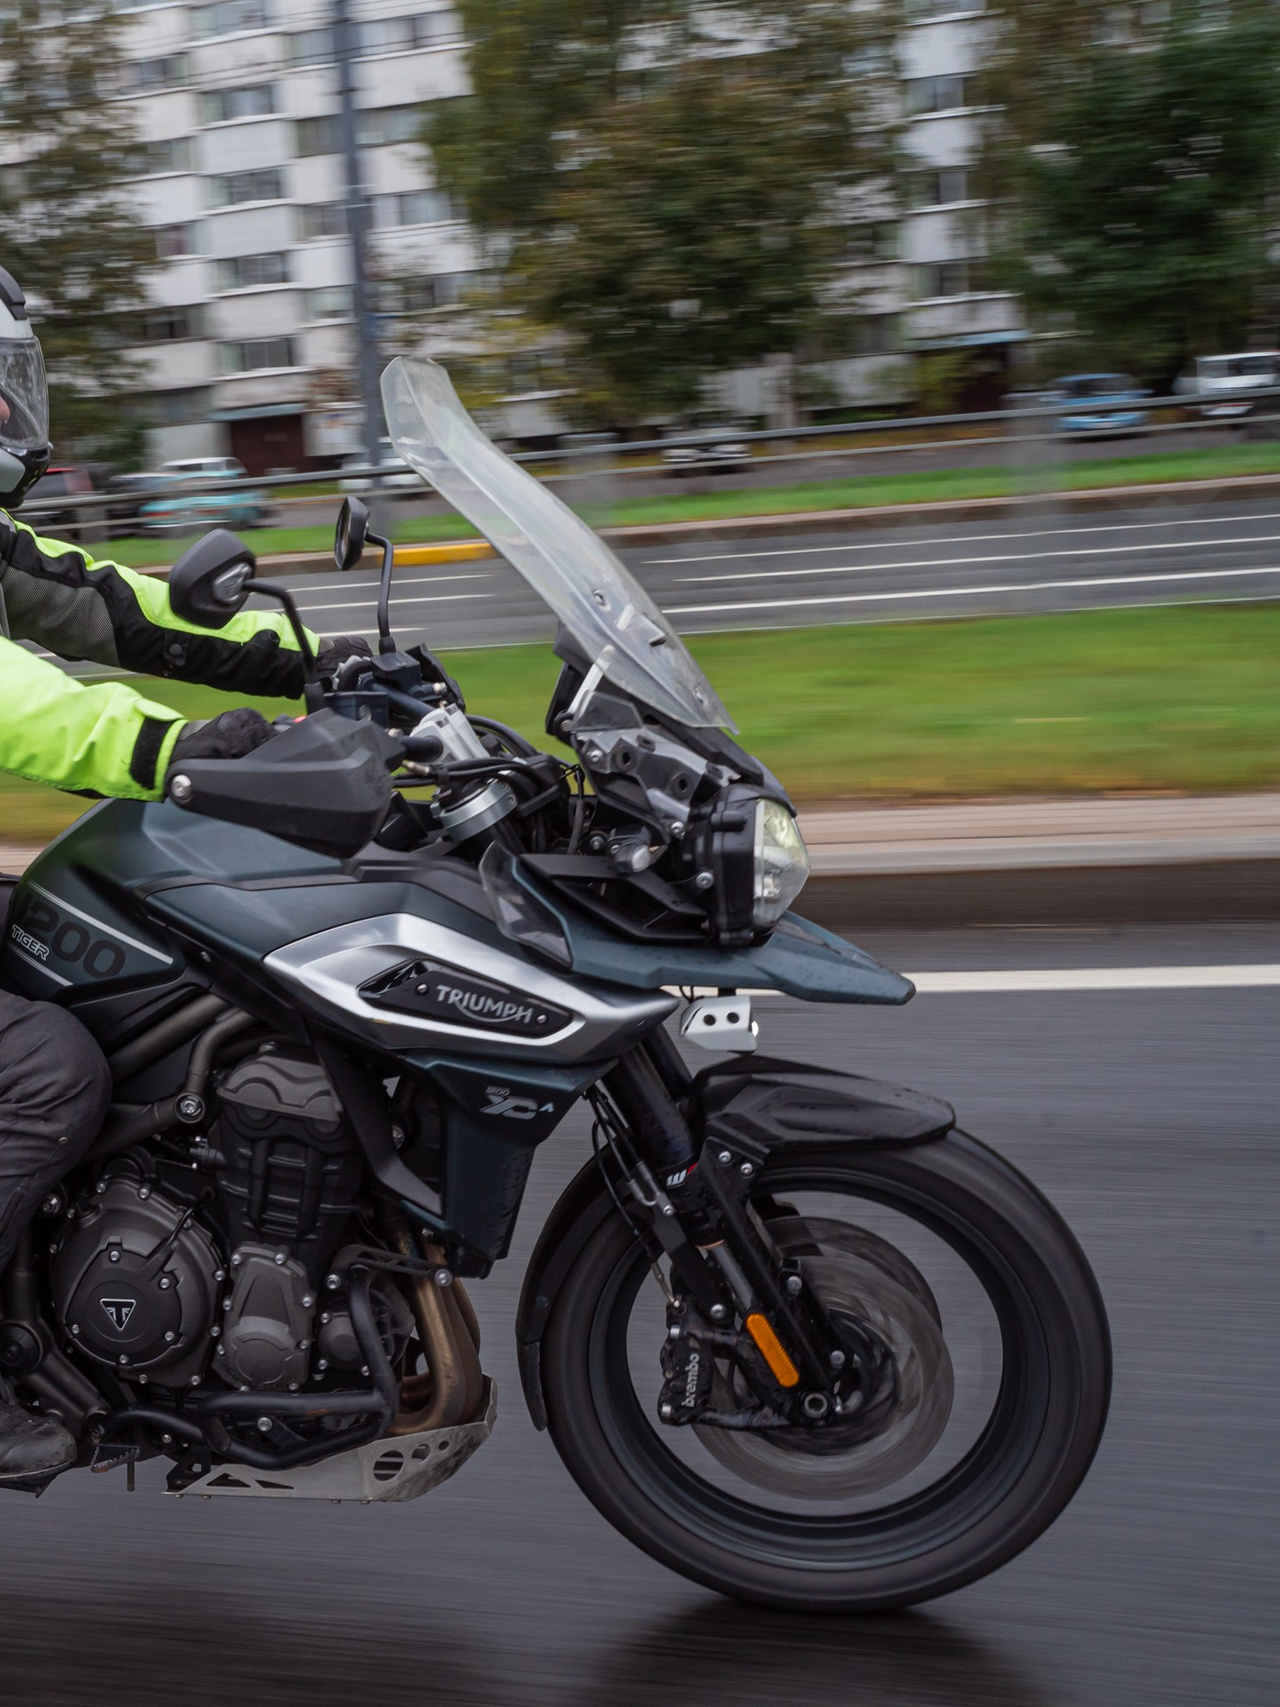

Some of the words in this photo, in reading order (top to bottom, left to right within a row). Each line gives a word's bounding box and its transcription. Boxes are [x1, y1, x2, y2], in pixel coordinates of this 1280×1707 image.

[11, 923, 50, 961] TIGER
[436, 984, 534, 1024] TRIUMPH
[681, 1353, 700, 1408] brembo
